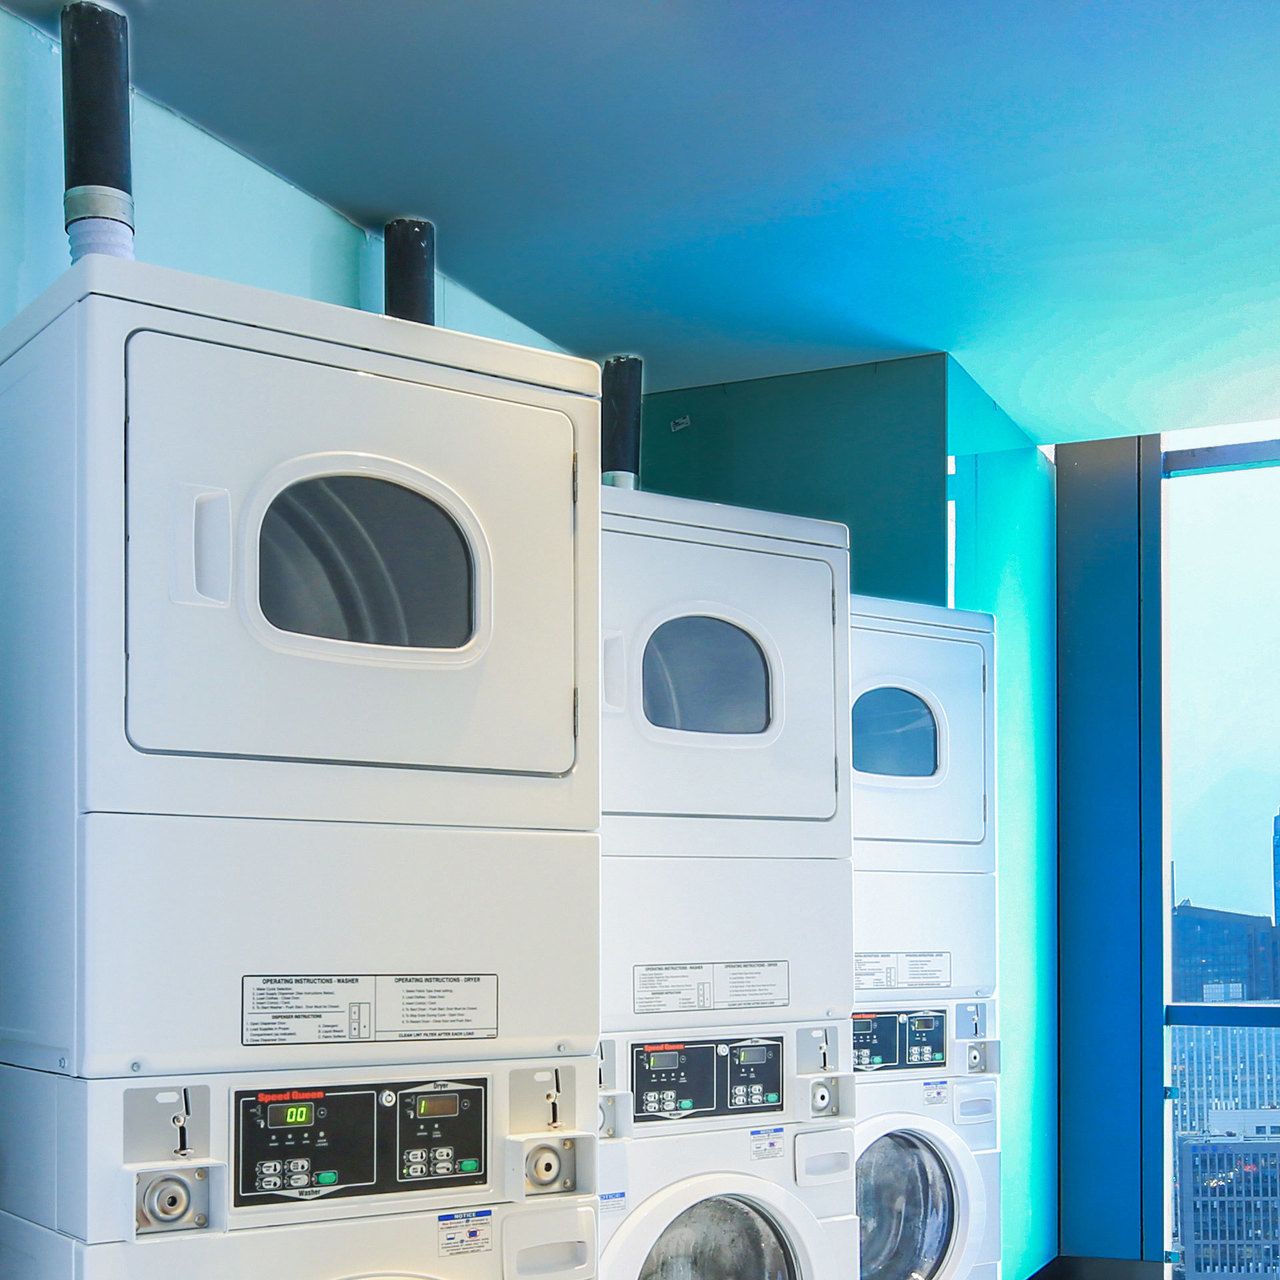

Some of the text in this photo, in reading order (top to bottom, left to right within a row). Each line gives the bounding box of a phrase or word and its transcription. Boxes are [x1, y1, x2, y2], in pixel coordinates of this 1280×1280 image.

[258, 1091, 324, 1102] Speed Queen
[287, 1107, 306, 1122] 00
